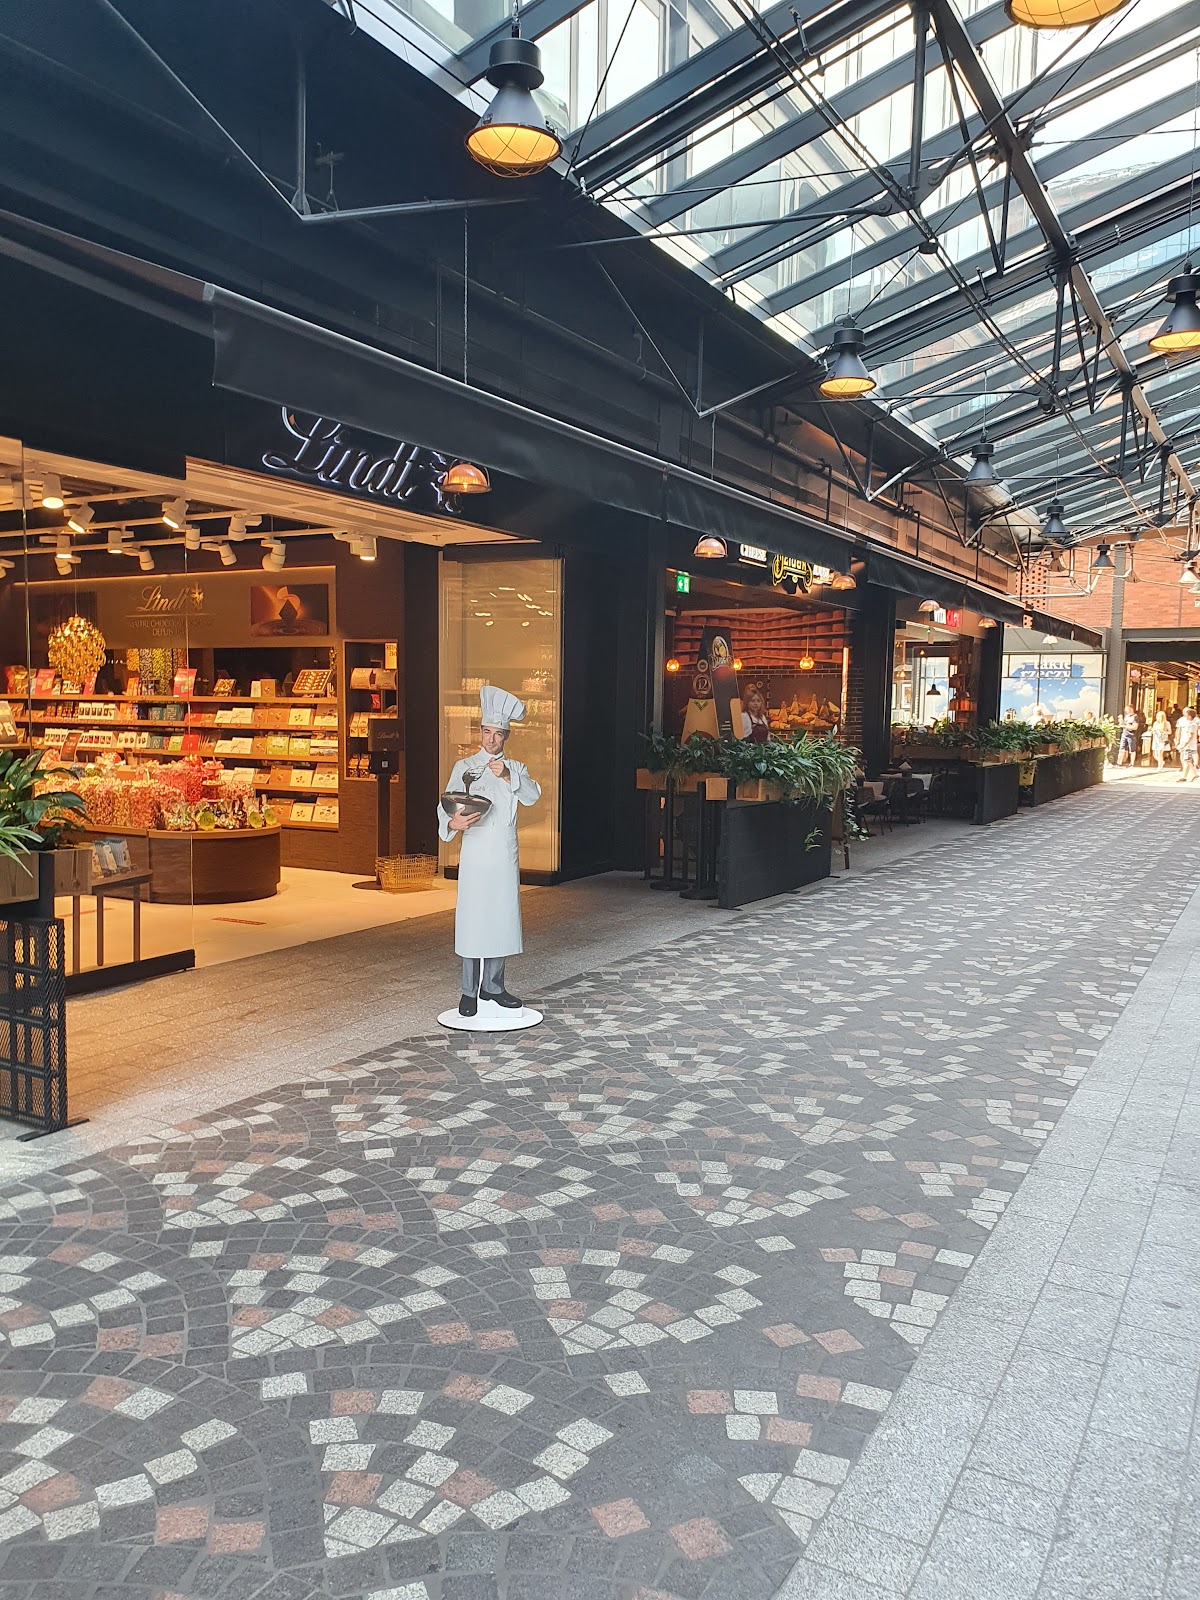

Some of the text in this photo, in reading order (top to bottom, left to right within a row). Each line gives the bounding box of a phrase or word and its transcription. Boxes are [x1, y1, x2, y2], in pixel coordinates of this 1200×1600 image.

[261, 406, 418, 500] Lindt
[740, 543, 767, 562] CHEESE
[136, 585, 190, 611] Lindt
[1020, 670, 1071, 685] rzeczy
